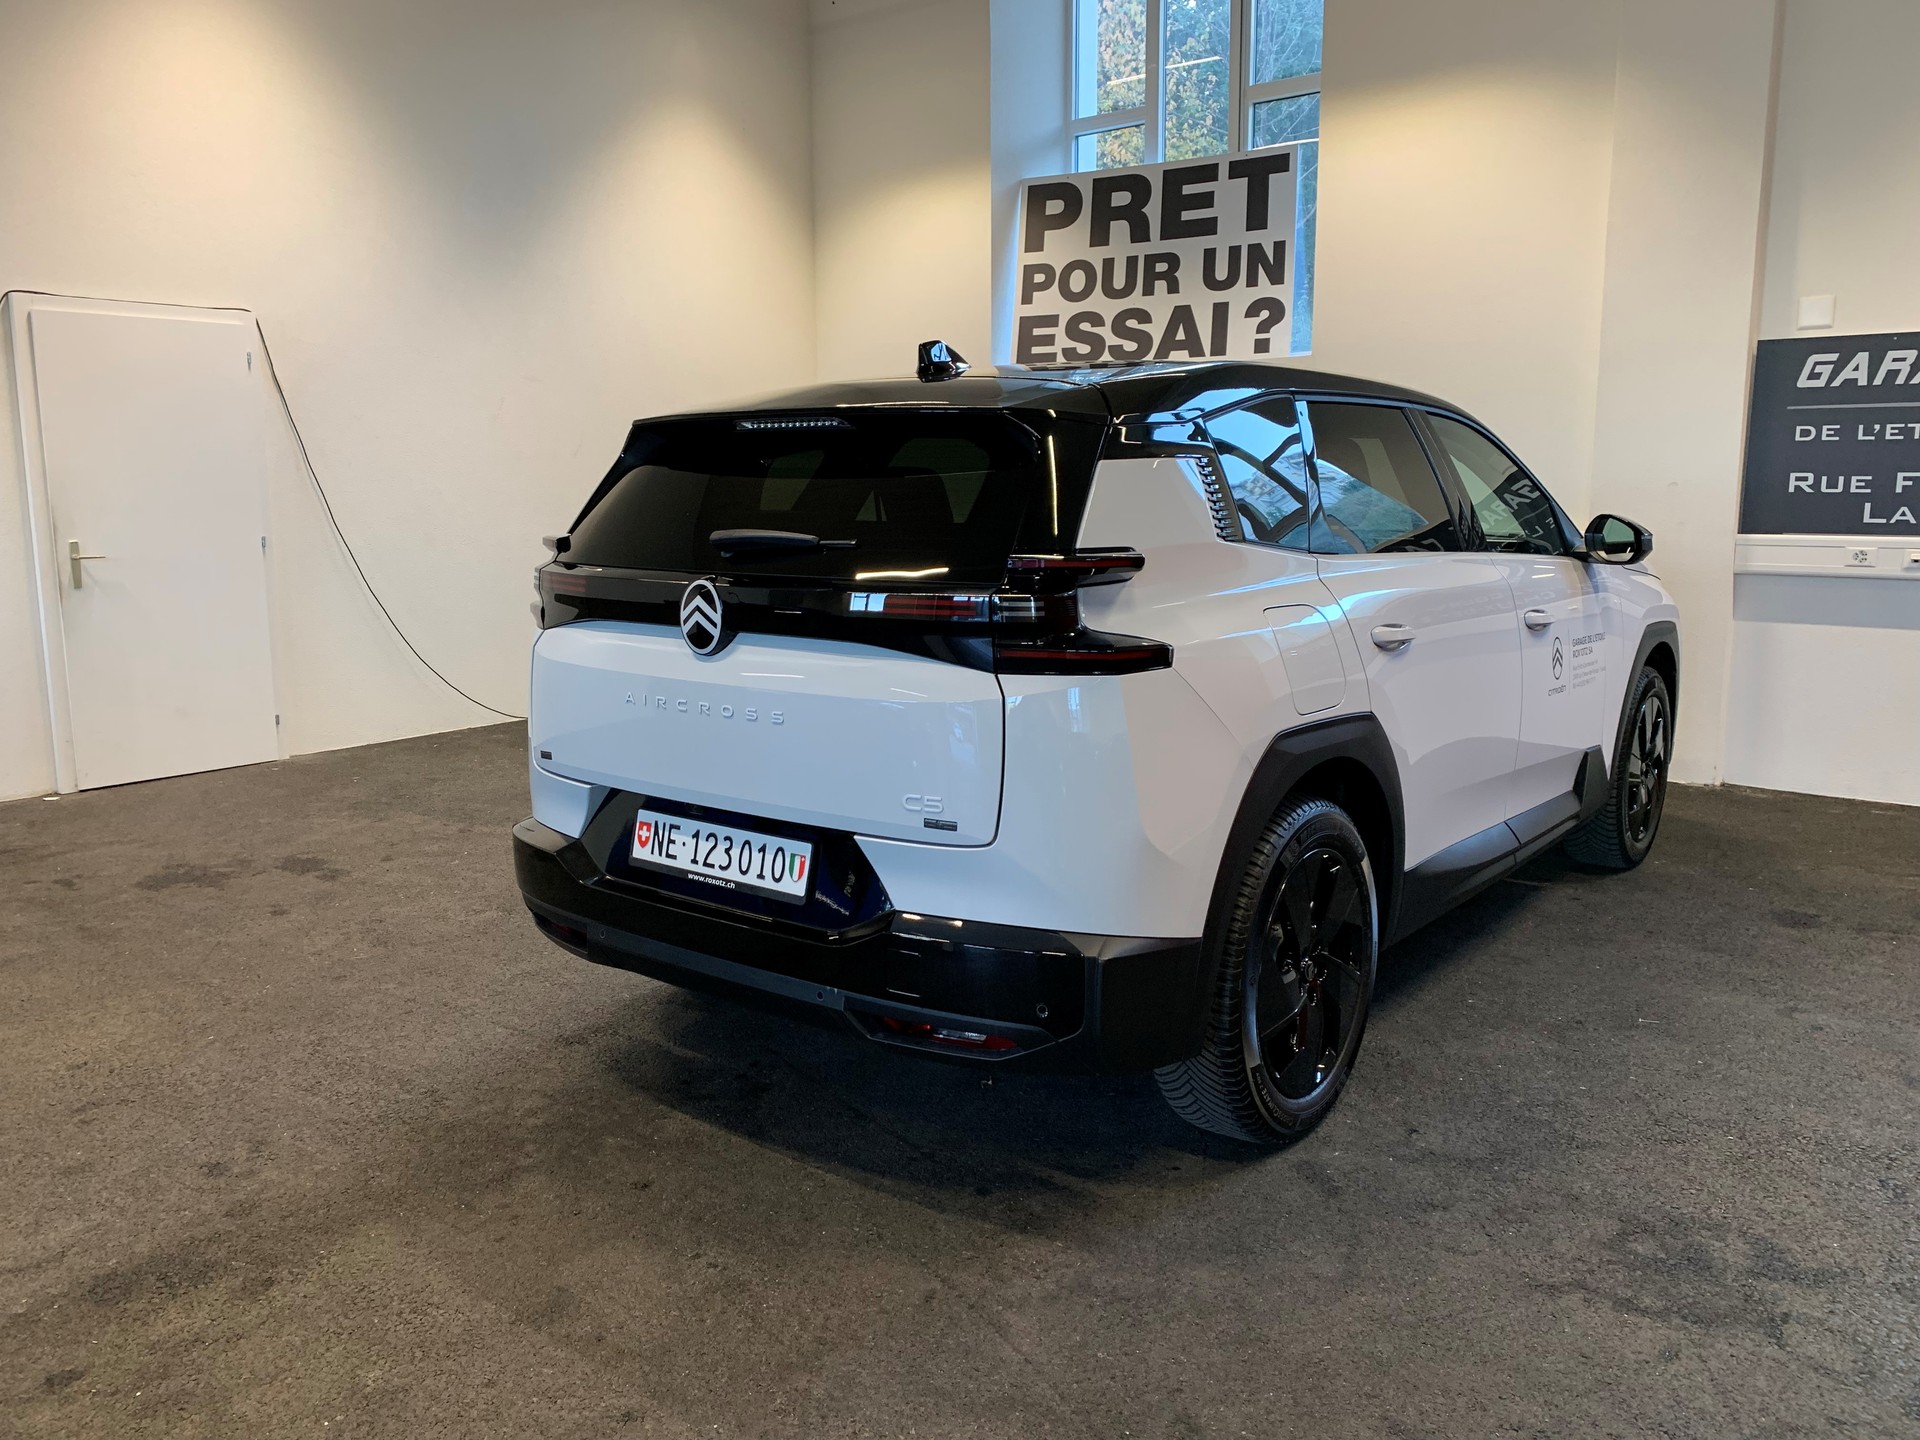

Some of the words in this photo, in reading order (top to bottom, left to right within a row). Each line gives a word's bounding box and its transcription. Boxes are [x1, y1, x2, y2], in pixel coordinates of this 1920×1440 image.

[1024, 152, 1290, 253] PRET
[1021, 252, 1181, 305] POUR
[1202, 240, 1287, 291] UN
[1796, 350, 1920, 388] GAR
[1794, 424, 1841, 441] DE
[1862, 502, 1917, 524] LA
[625, 691, 785, 725] AIRCROSS
[903, 793, 945, 813] C5
[687, 872, 736, 889] www.roxotz.ch
